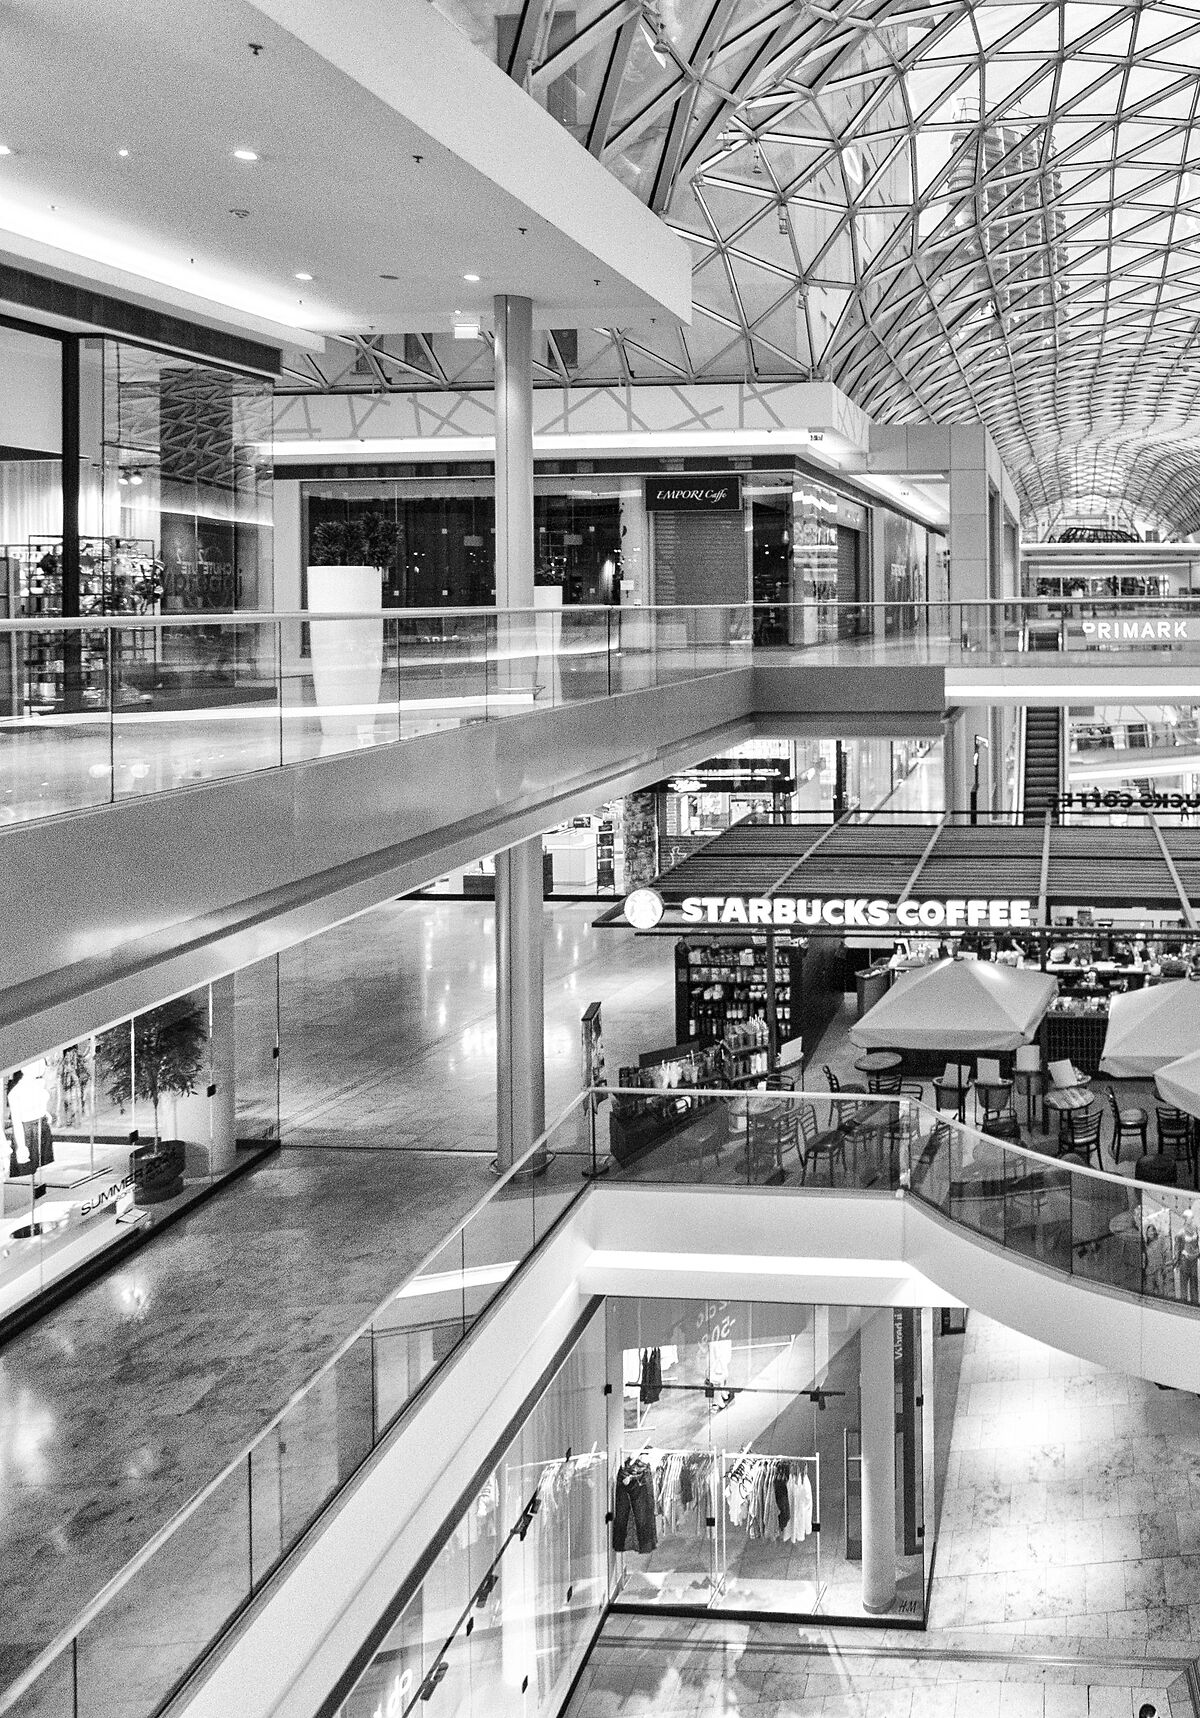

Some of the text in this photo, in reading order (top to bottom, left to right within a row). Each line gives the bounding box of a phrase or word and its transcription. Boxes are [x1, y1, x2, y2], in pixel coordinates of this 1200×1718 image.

[656, 489, 703, 501] EMPORI
[1082, 621, 1188, 640] PRIMARK
[681, 897, 1031, 927] STARBUCKS COFFEE
